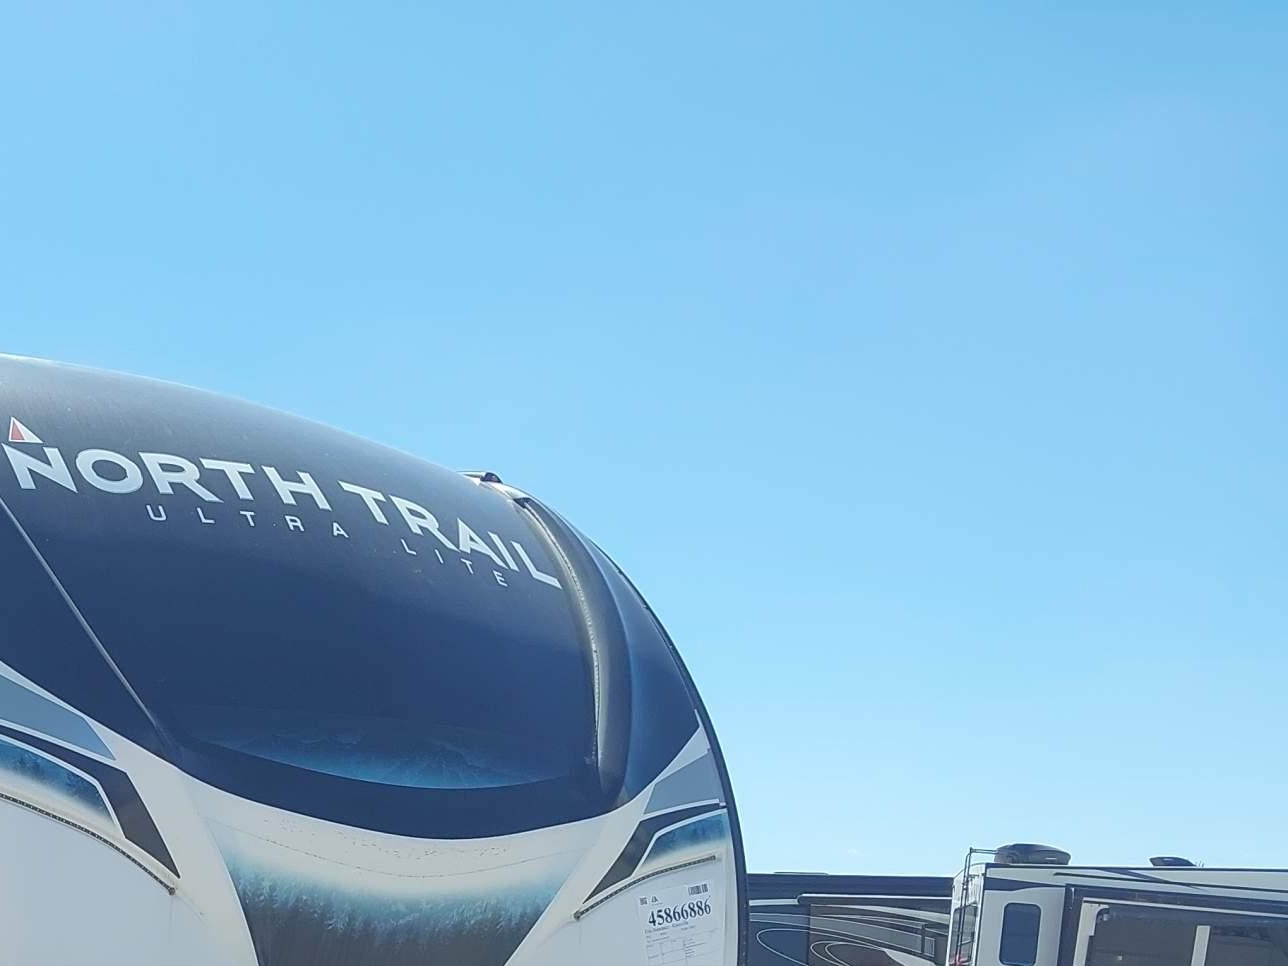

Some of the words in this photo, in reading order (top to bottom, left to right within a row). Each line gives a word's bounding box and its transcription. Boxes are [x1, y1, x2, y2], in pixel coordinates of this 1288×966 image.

[1, 442, 332, 512] NORTH
[337, 481, 563, 590] TRAIL
[145, 503, 350, 539] ULTRA
[400, 539, 509, 588] LITE
[648, 895, 712, 927] 45866886
